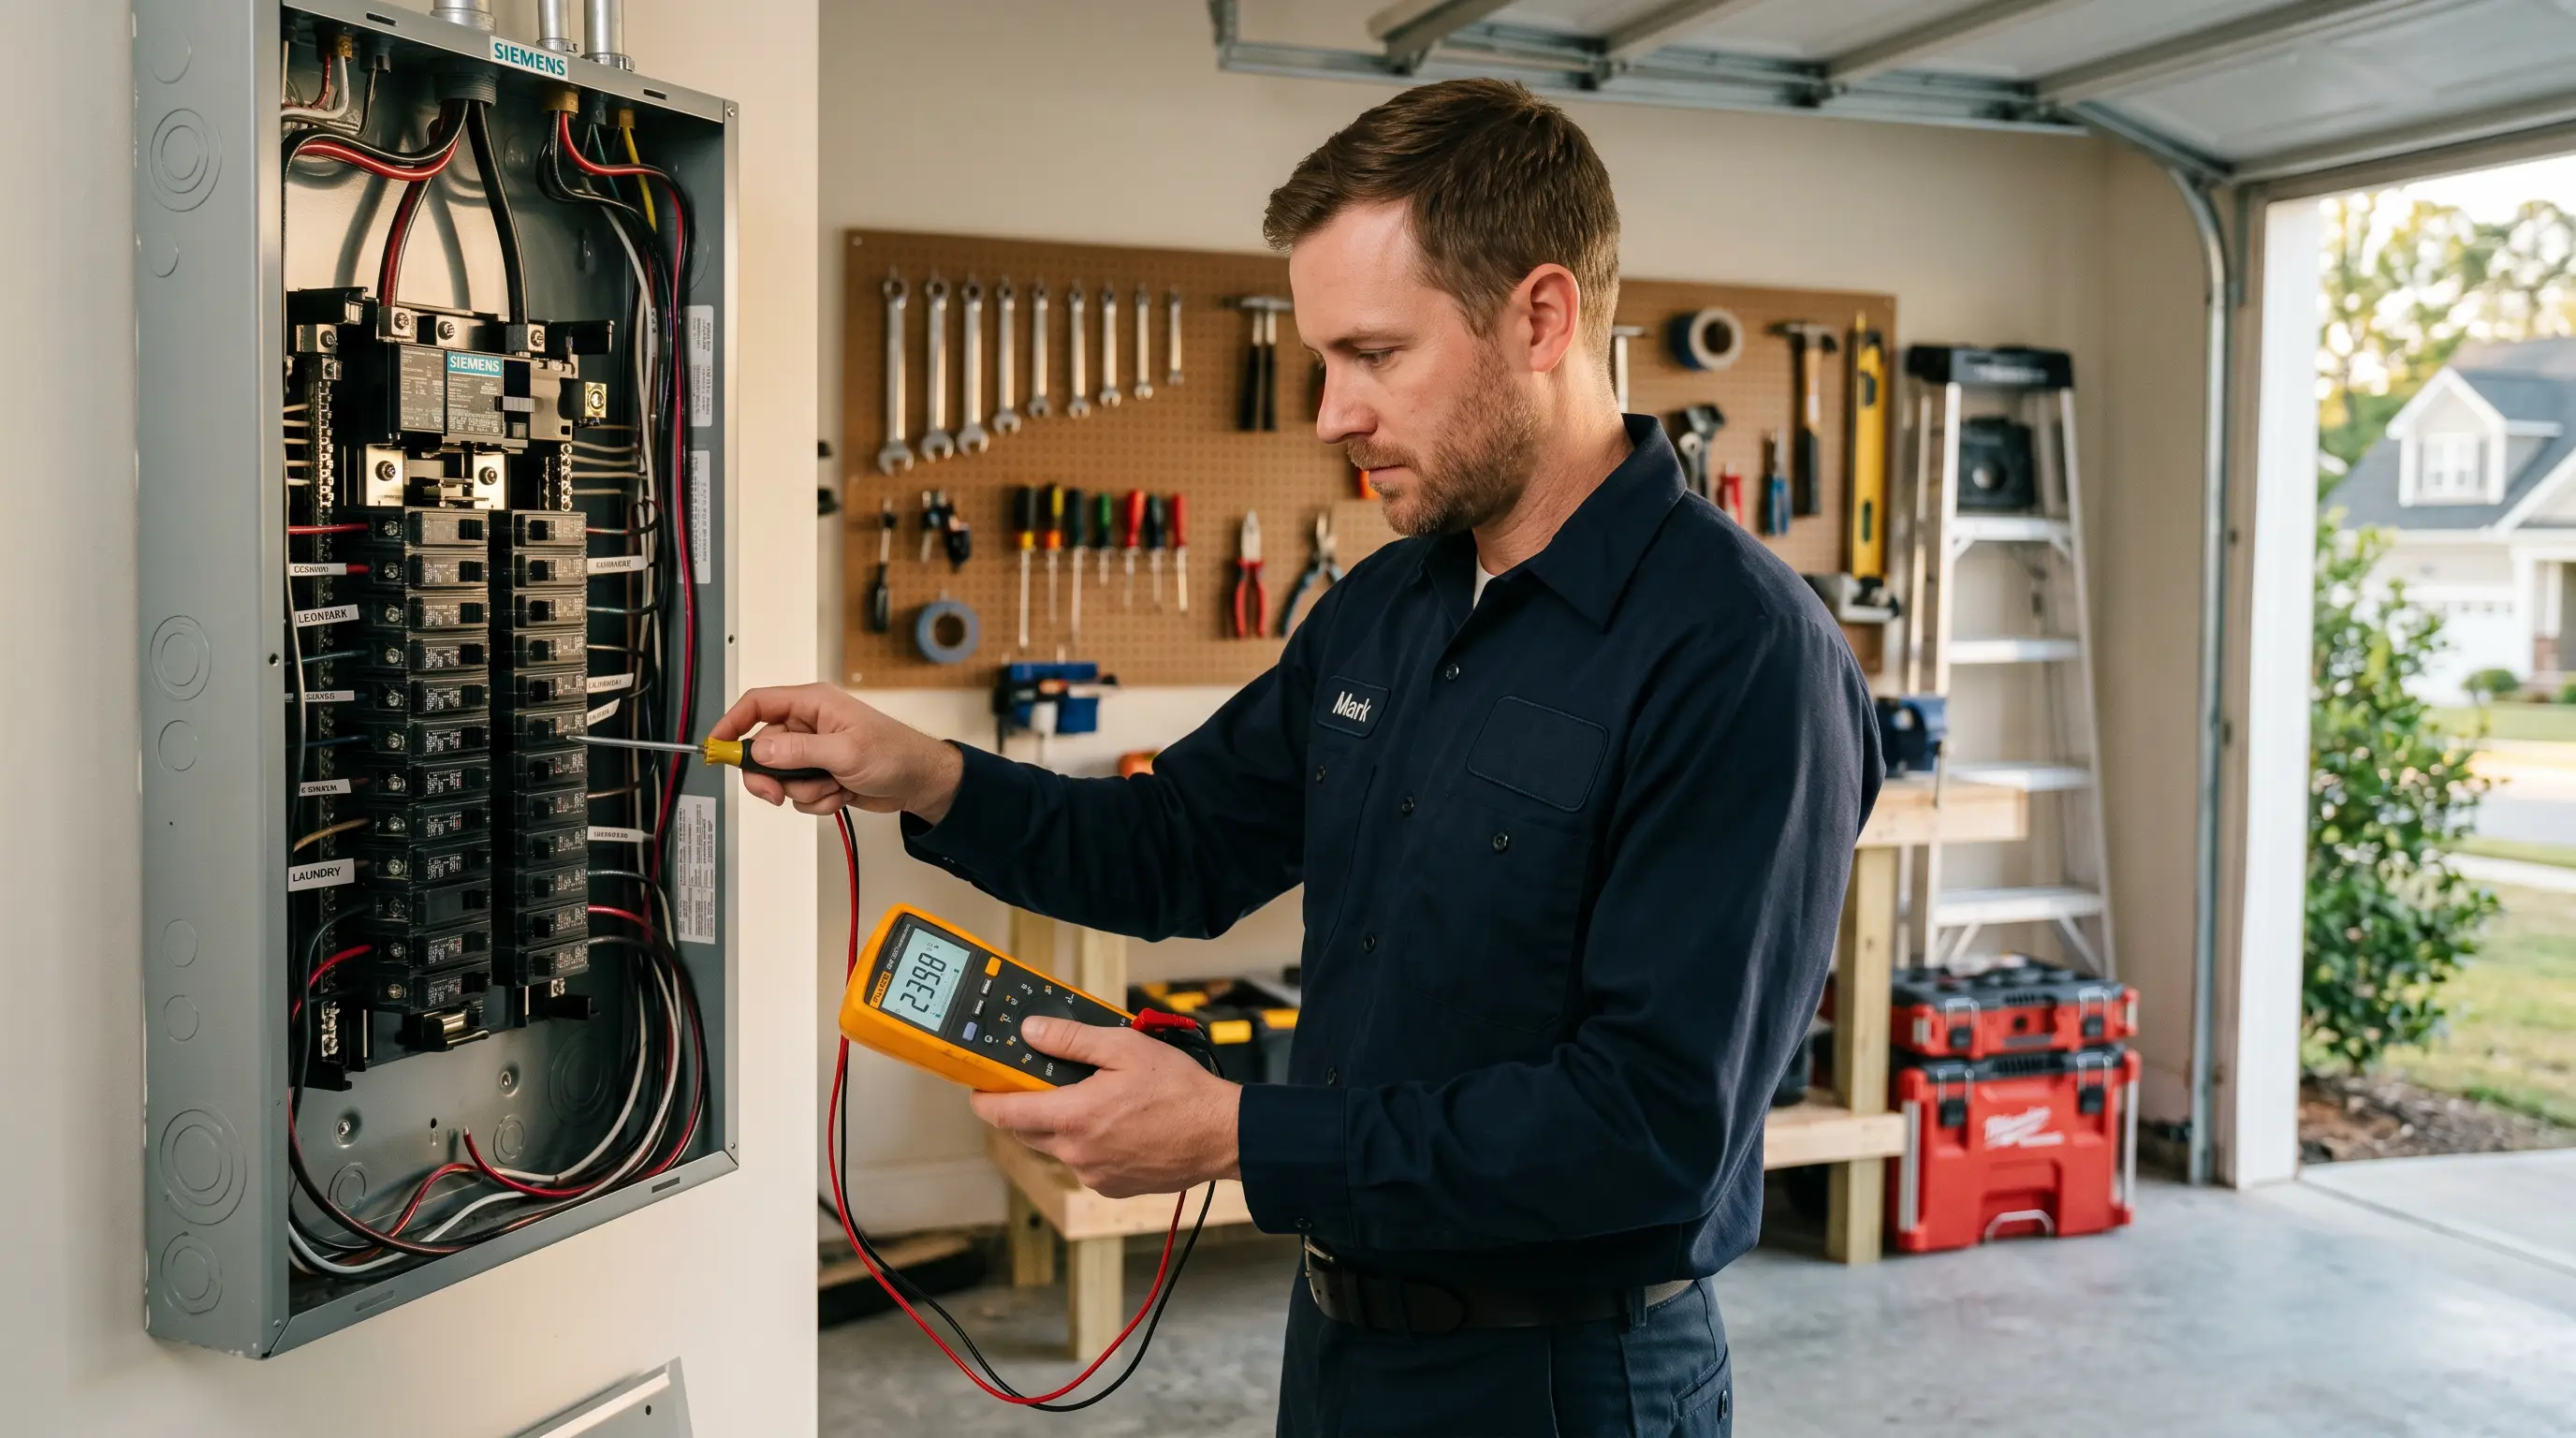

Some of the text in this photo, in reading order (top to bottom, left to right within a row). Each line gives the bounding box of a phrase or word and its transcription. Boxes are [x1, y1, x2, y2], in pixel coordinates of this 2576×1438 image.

[494, 42, 565, 76] SIEMENS
[450, 356, 500, 372] SIEMENS
[1332, 691, 1371, 723] Mark
[292, 867, 341, 883] LAUNDRY
